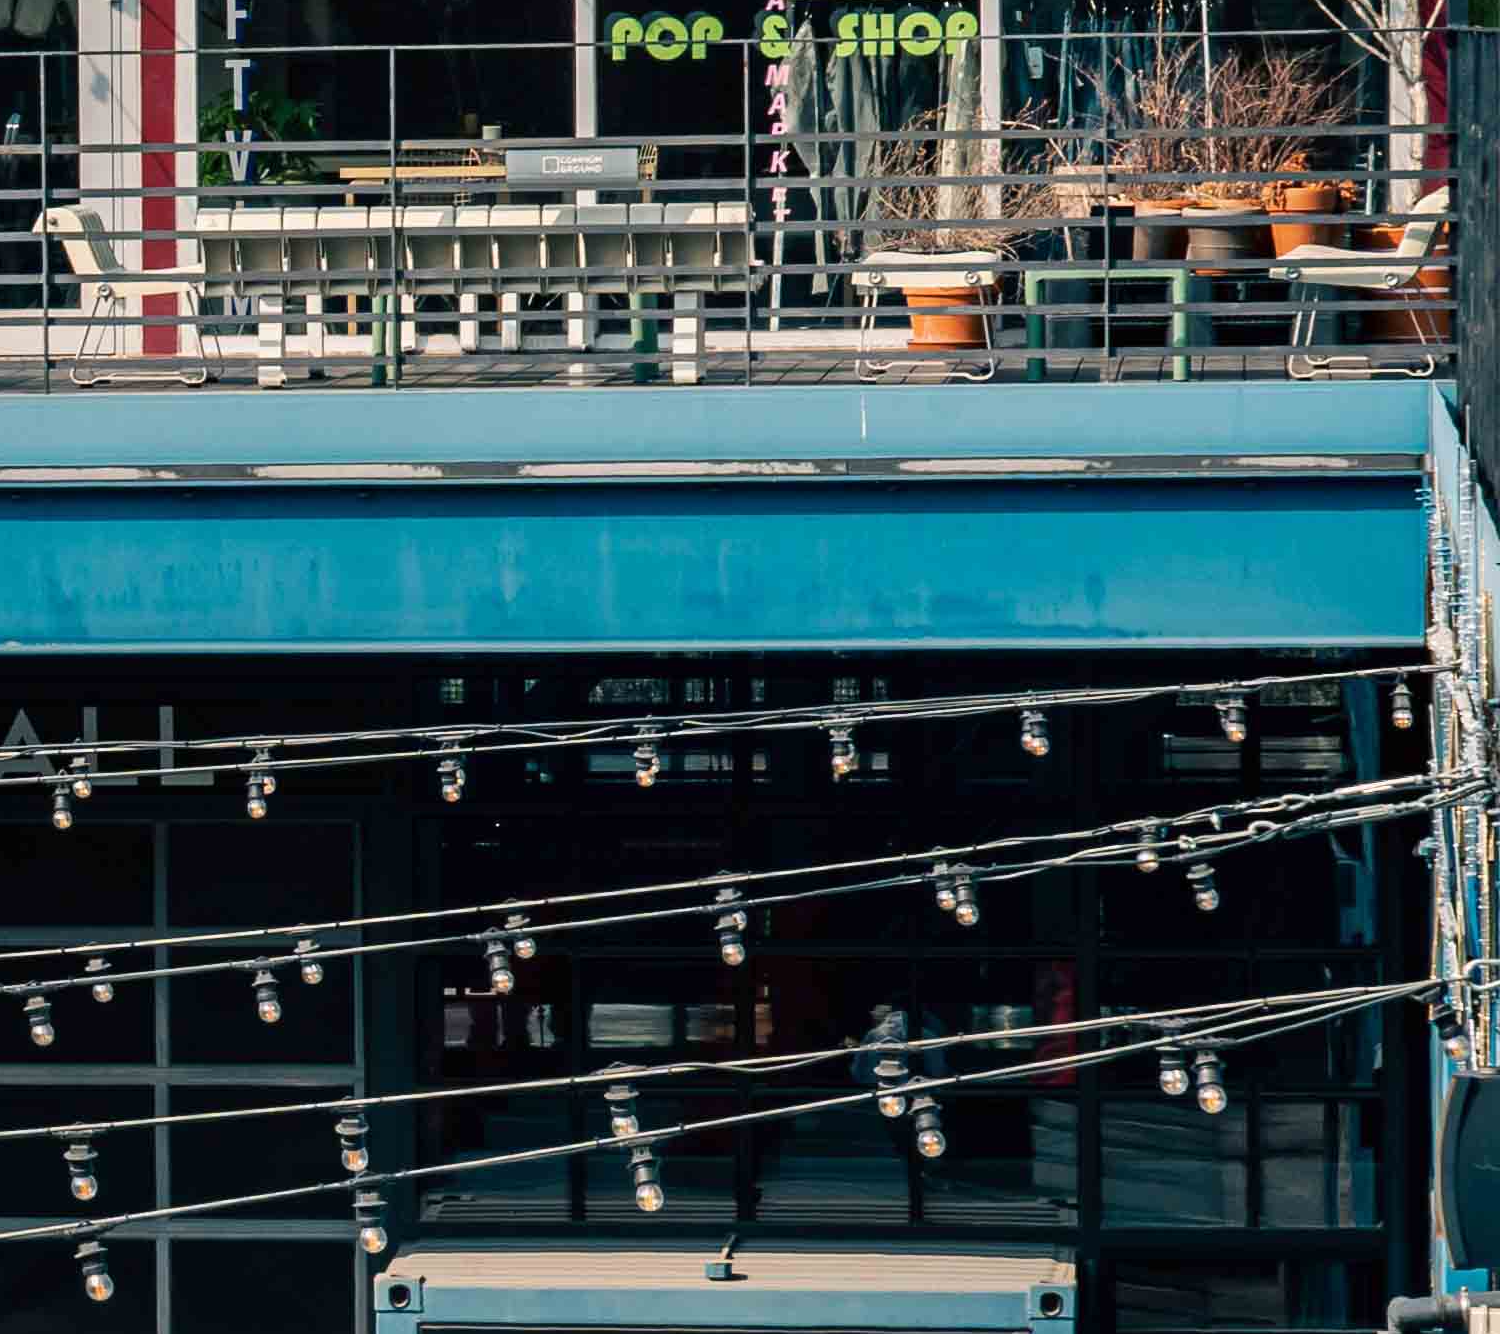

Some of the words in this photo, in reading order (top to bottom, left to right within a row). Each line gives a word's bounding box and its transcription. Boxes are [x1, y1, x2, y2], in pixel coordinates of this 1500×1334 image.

[611, 15, 724, 61] POP
[759, 14, 790, 59] &
[835, 11, 979, 58] SHOP
